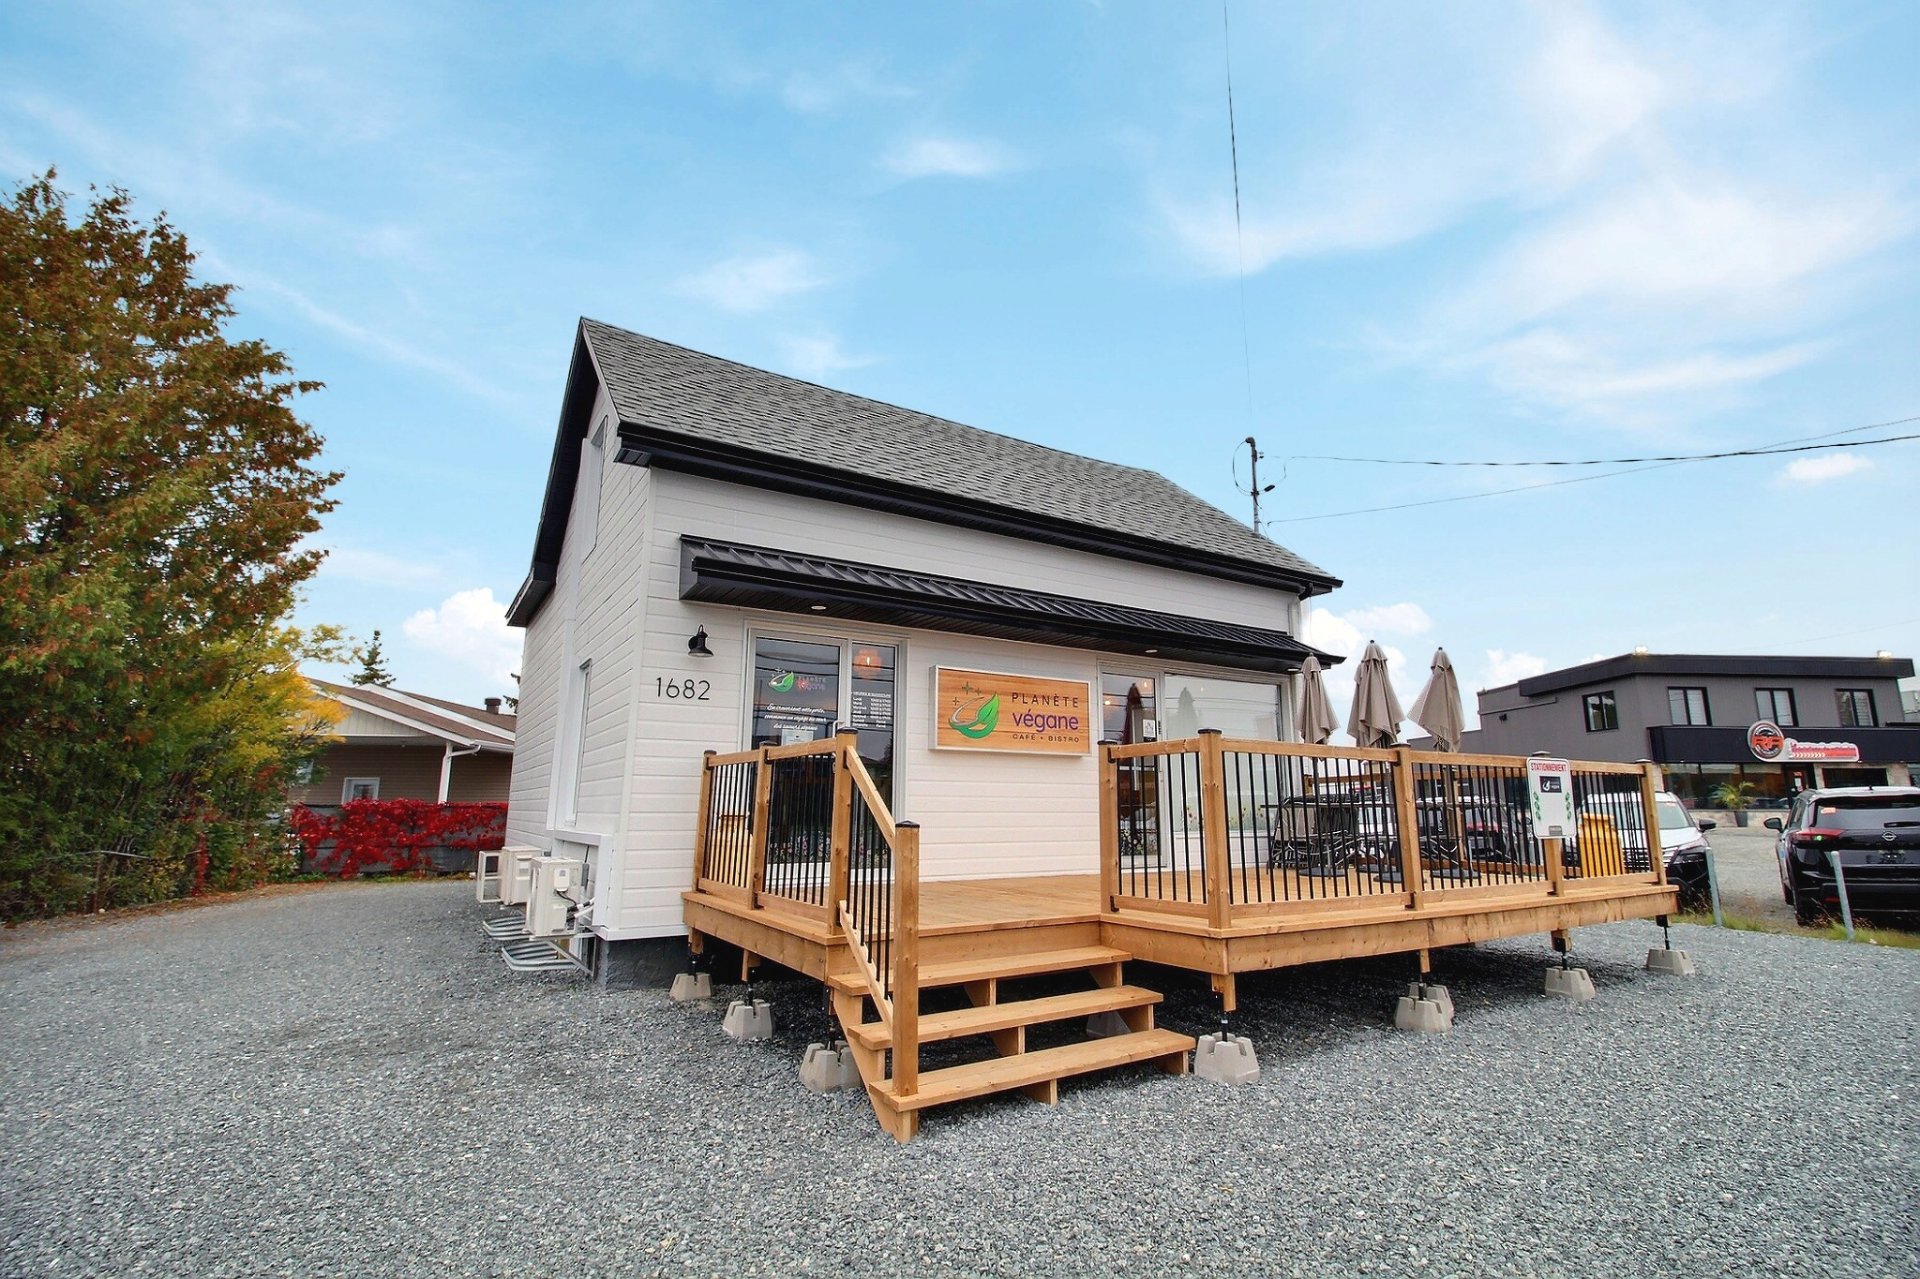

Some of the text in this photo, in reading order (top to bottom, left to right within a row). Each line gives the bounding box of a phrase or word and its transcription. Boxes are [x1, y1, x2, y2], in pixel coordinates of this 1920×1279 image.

[656, 677, 711, 701] 1682
[1012, 692, 1079, 707] PLANÈTE
[1012, 709, 1079, 732] végane
[1012, 732, 1036, 740] CAFÉ
[1531, 763, 1567, 772] STATIONNEMENT
